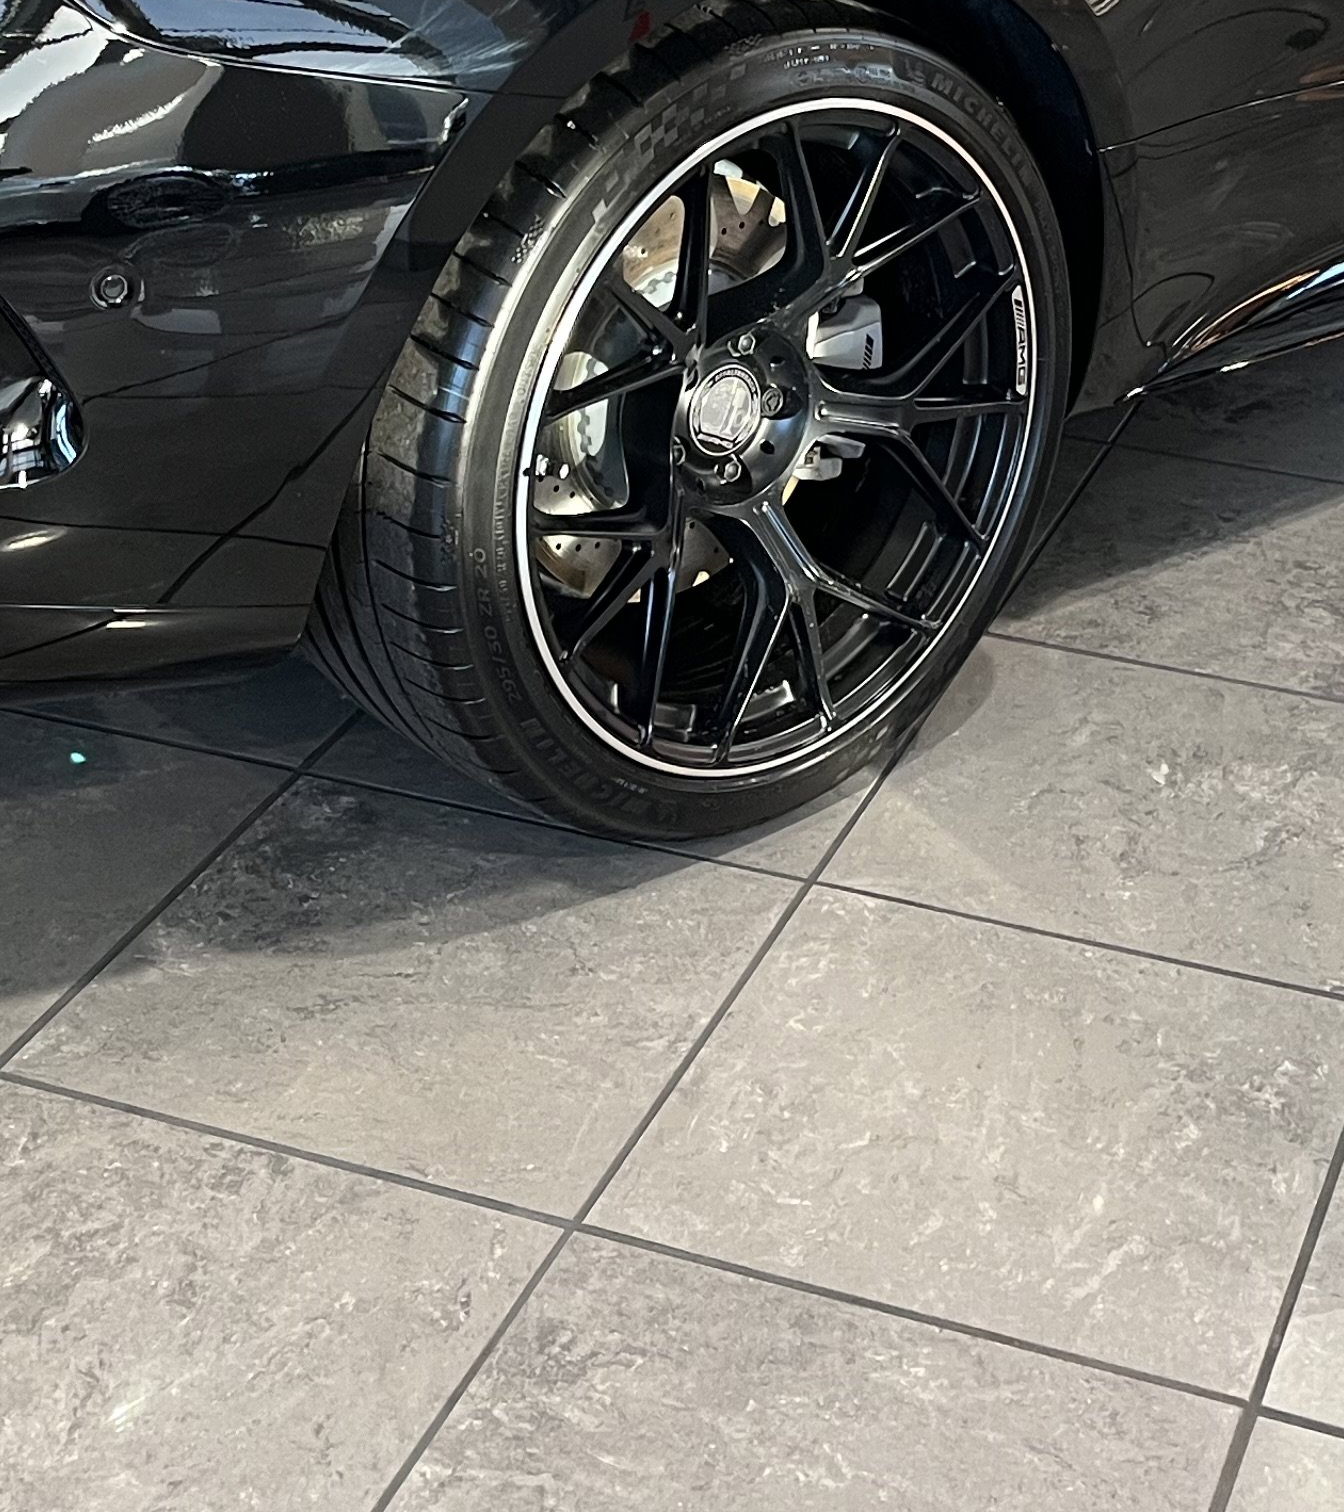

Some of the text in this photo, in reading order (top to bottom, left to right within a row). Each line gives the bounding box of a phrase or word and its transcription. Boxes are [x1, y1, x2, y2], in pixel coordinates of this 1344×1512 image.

[931, 71, 1033, 184] MICHELIN
[1016, 326, 1027, 386] AMG
[473, 547, 488, 579] 20
[476, 586, 494, 617] ZR
[484, 625, 522, 703] 295/30
